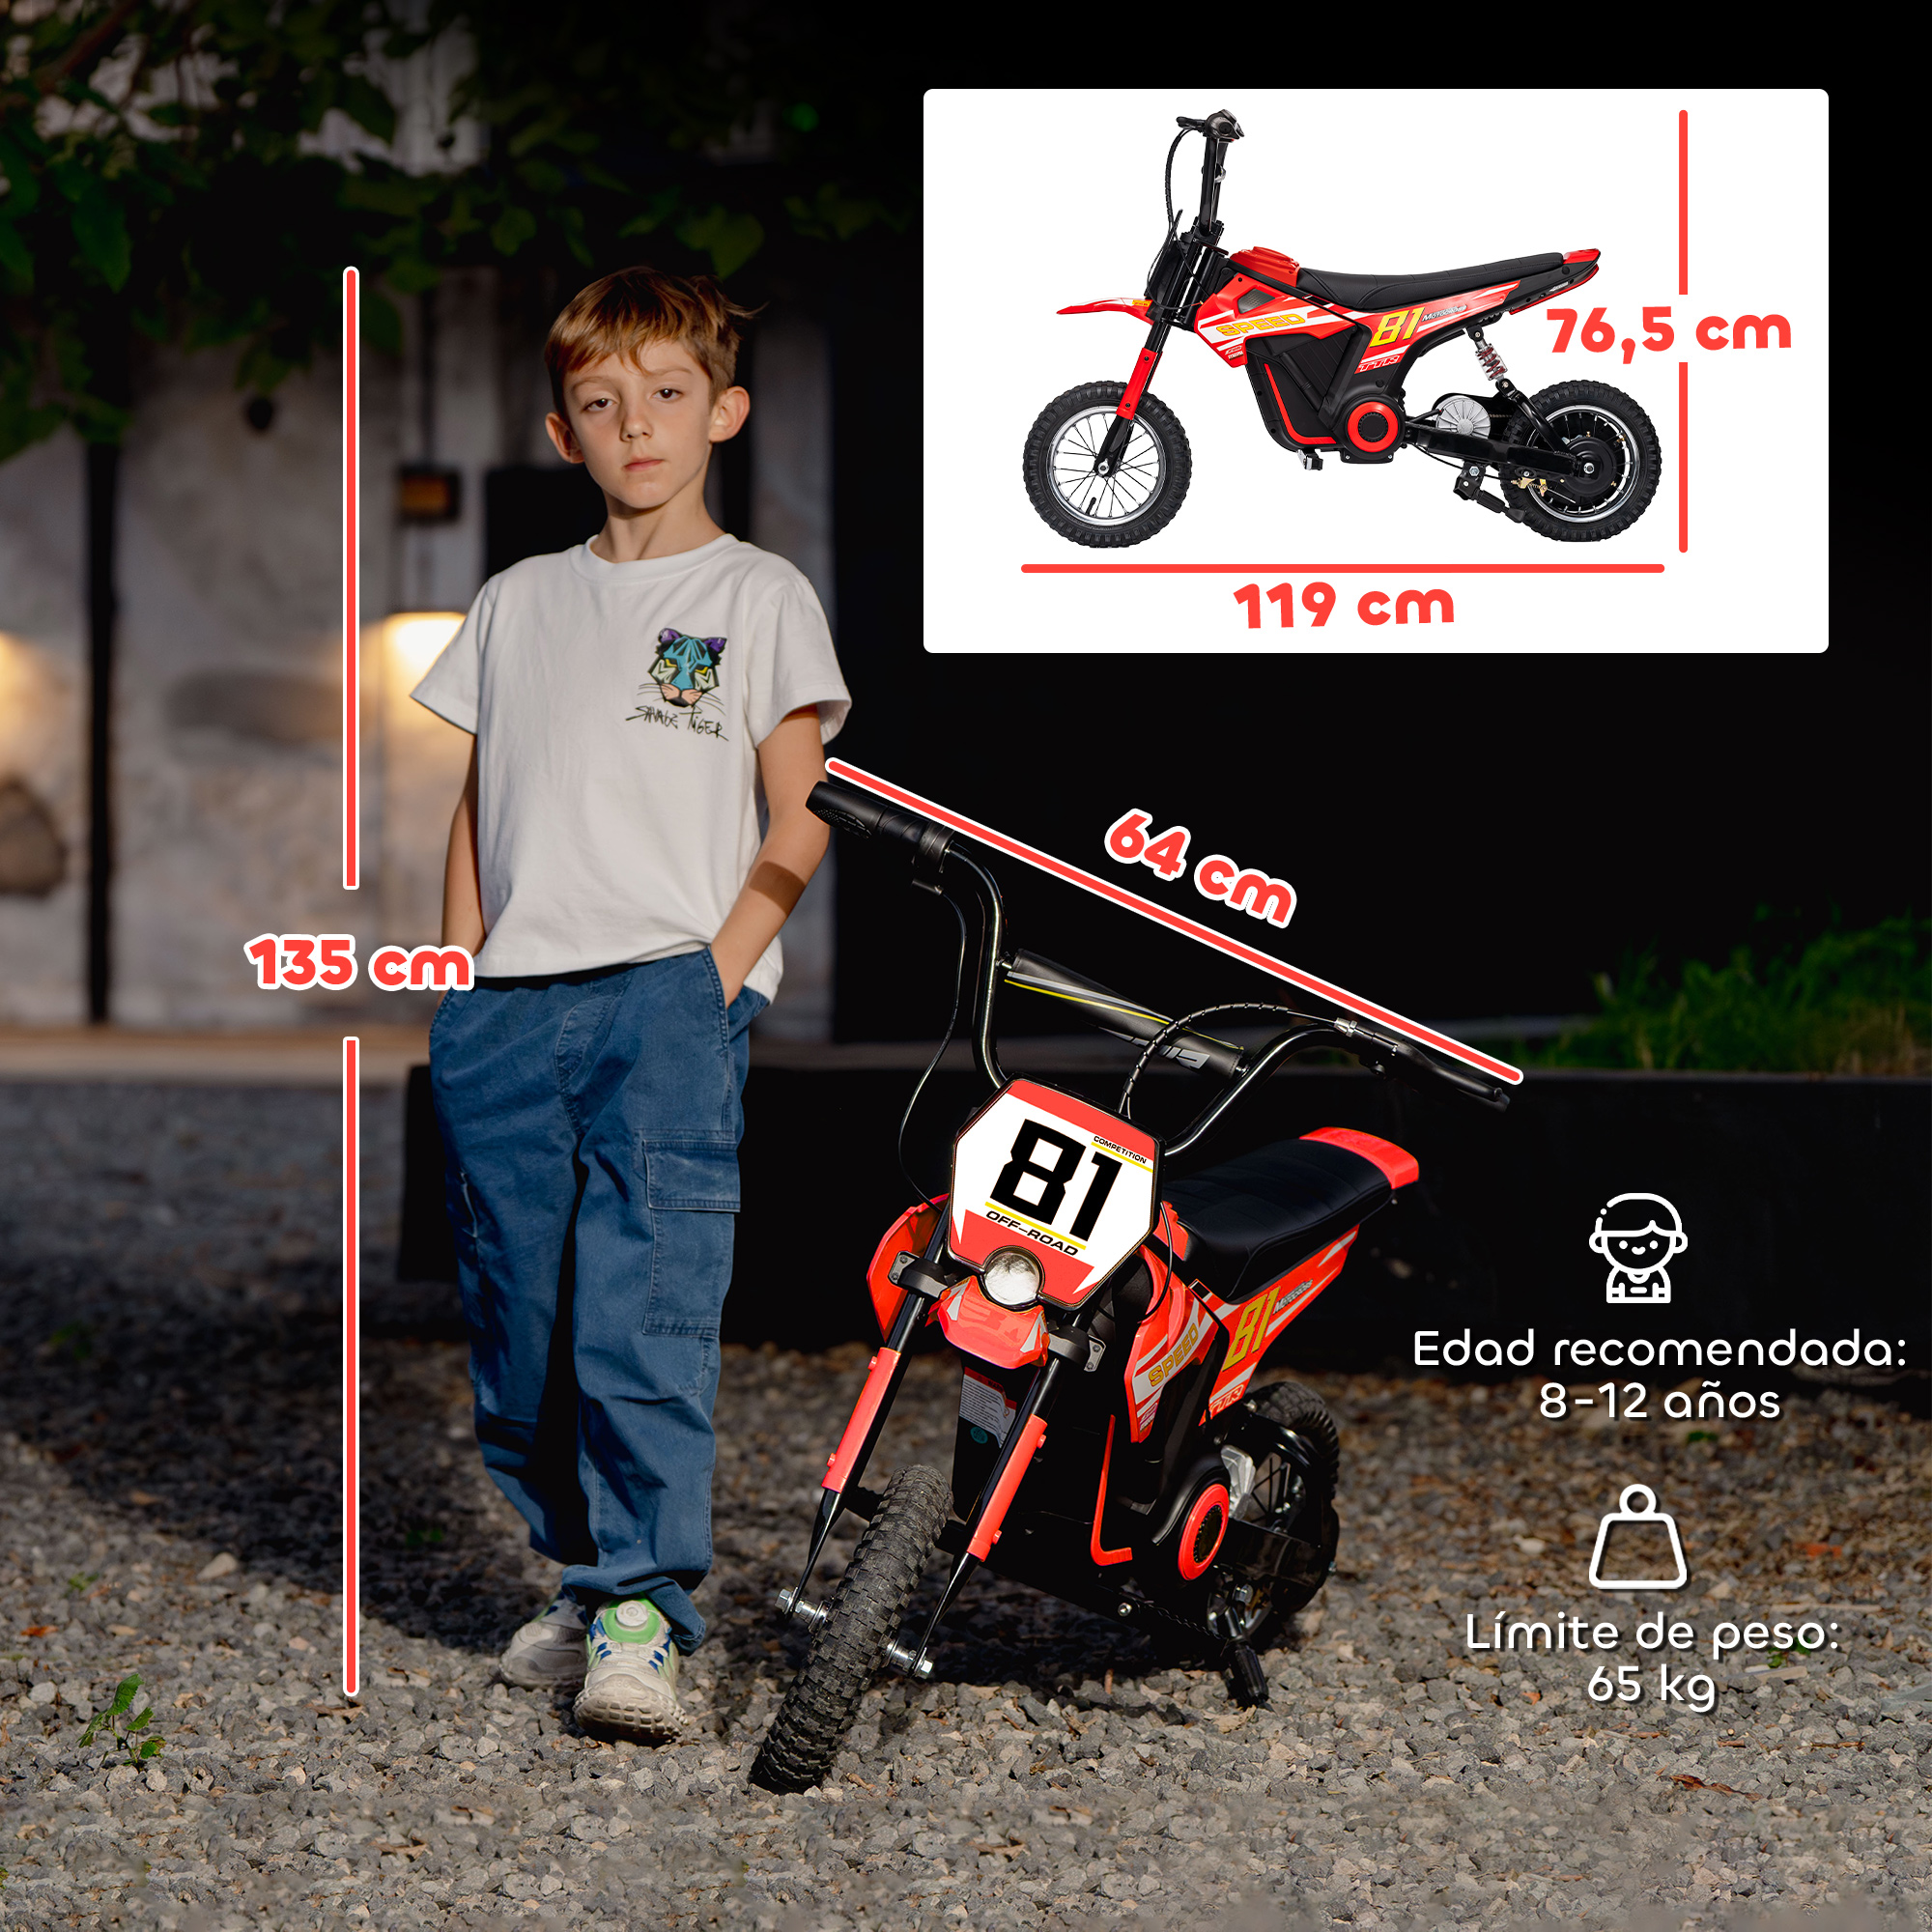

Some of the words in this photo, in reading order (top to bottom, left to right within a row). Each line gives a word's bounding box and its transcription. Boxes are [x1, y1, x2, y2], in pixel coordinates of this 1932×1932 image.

[1216, 313, 1306, 336] SPEED
[1369, 306, 1425, 348] 81
[1094, 1135, 1147, 1164] COMPETITION
[990, 1118, 1122, 1241] 81
[985, 1210, 1078, 1256] OFF-ROAD
[1222, 1286, 1281, 1372] 81
[1148, 1321, 1199, 1387] SPEED
